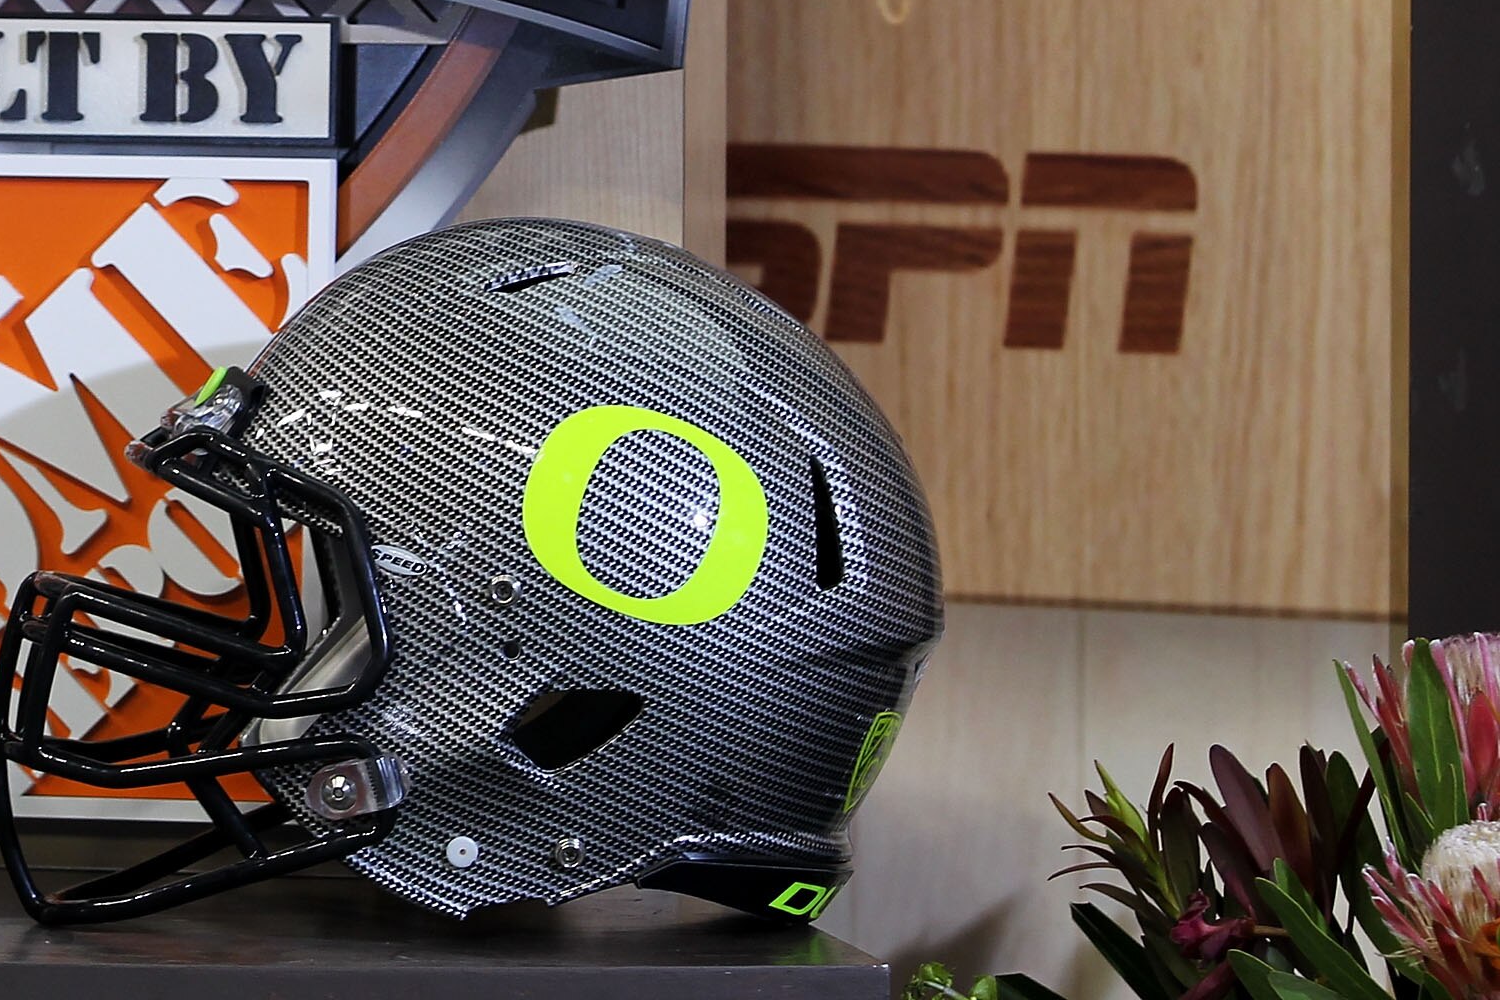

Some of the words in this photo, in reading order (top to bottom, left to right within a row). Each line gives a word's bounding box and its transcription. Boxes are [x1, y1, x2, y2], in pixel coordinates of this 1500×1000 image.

[140, 31, 302, 124] BY
[371, 548, 425, 574] SPEED
[522, 405, 768, 625] O
